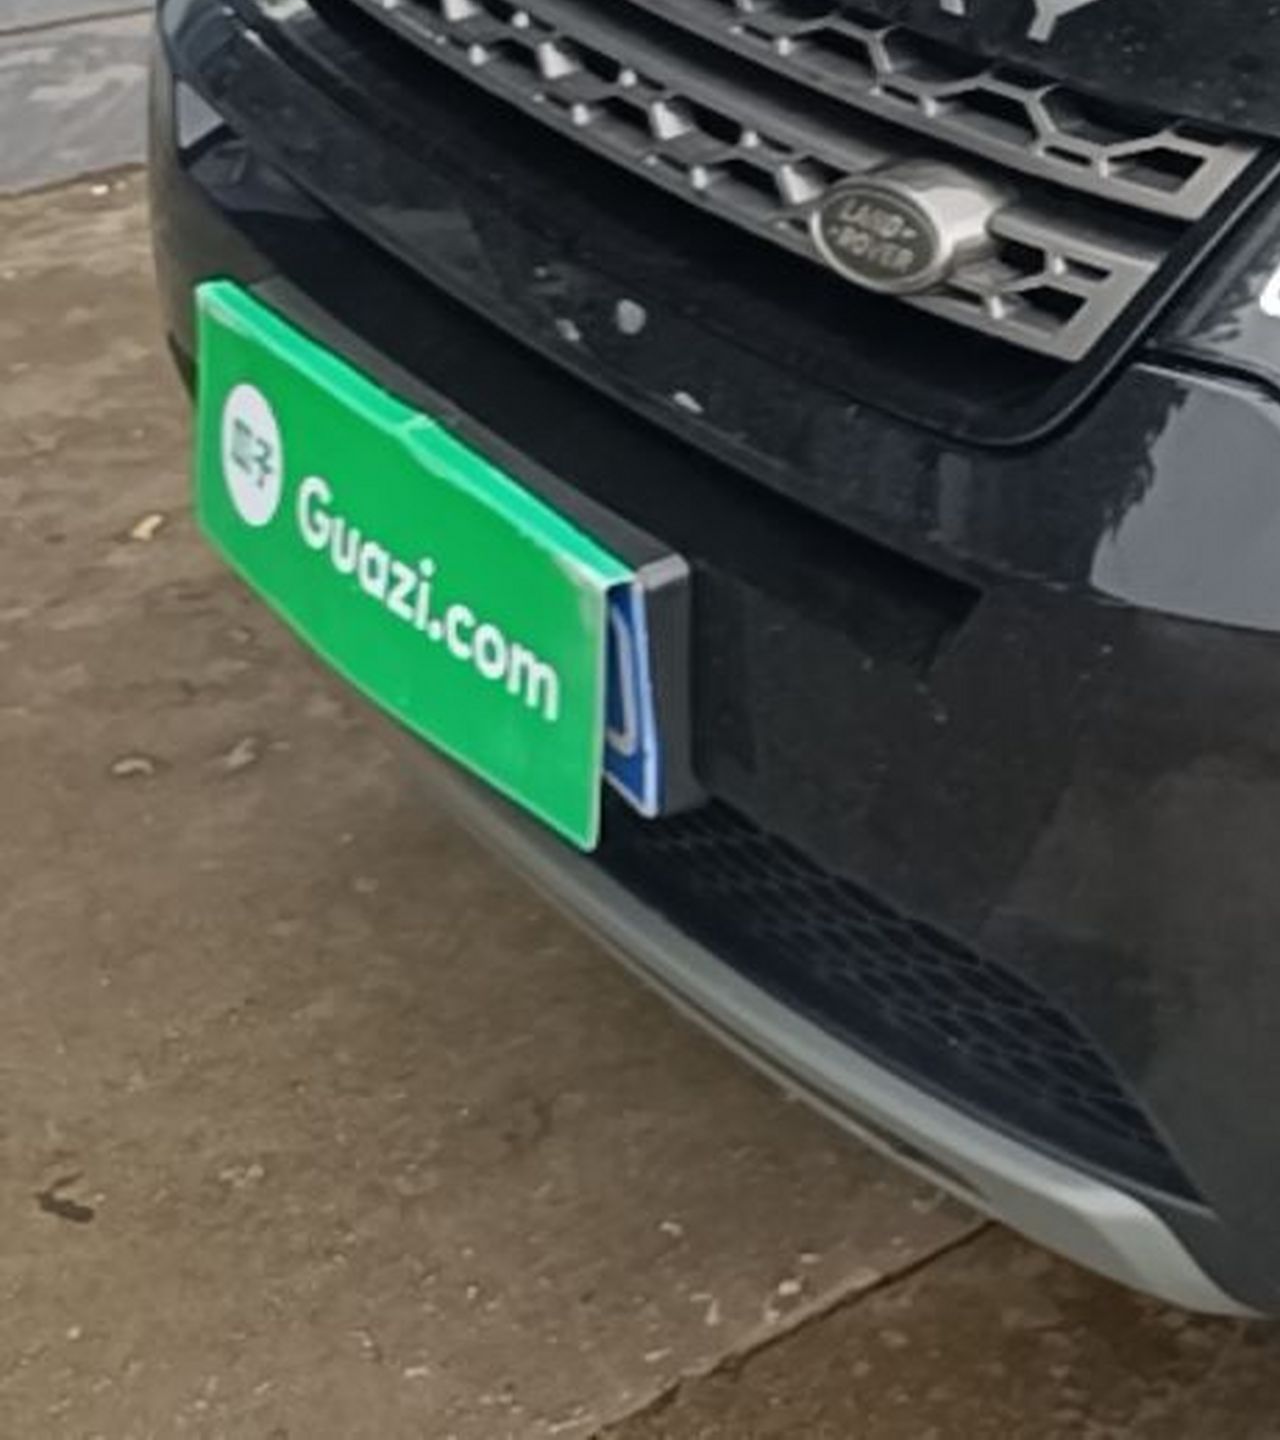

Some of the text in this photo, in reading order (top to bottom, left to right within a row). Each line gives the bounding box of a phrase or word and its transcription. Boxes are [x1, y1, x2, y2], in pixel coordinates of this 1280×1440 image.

[838, 198, 905, 238] LAND
[836, 226, 915, 274] ROVER
[296, 474, 562, 723] Guazi.com
